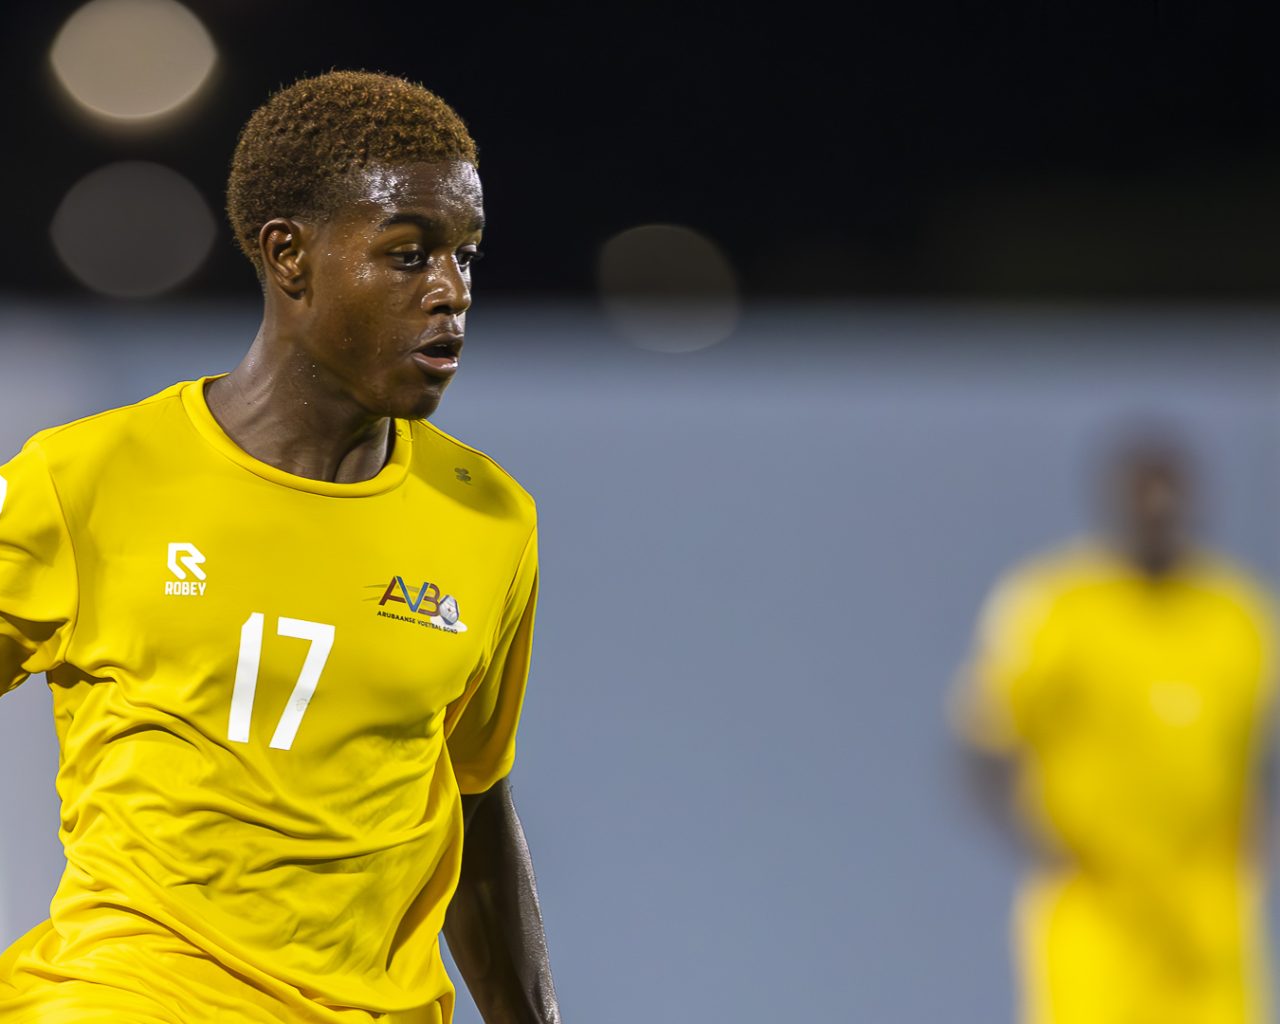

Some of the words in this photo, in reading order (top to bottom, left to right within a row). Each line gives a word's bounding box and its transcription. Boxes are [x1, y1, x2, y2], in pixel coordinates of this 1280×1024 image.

[165, 581, 207, 596] ROBEY
[376, 611, 416, 624] ARUBAANSE
[227, 612, 336, 751] 17
